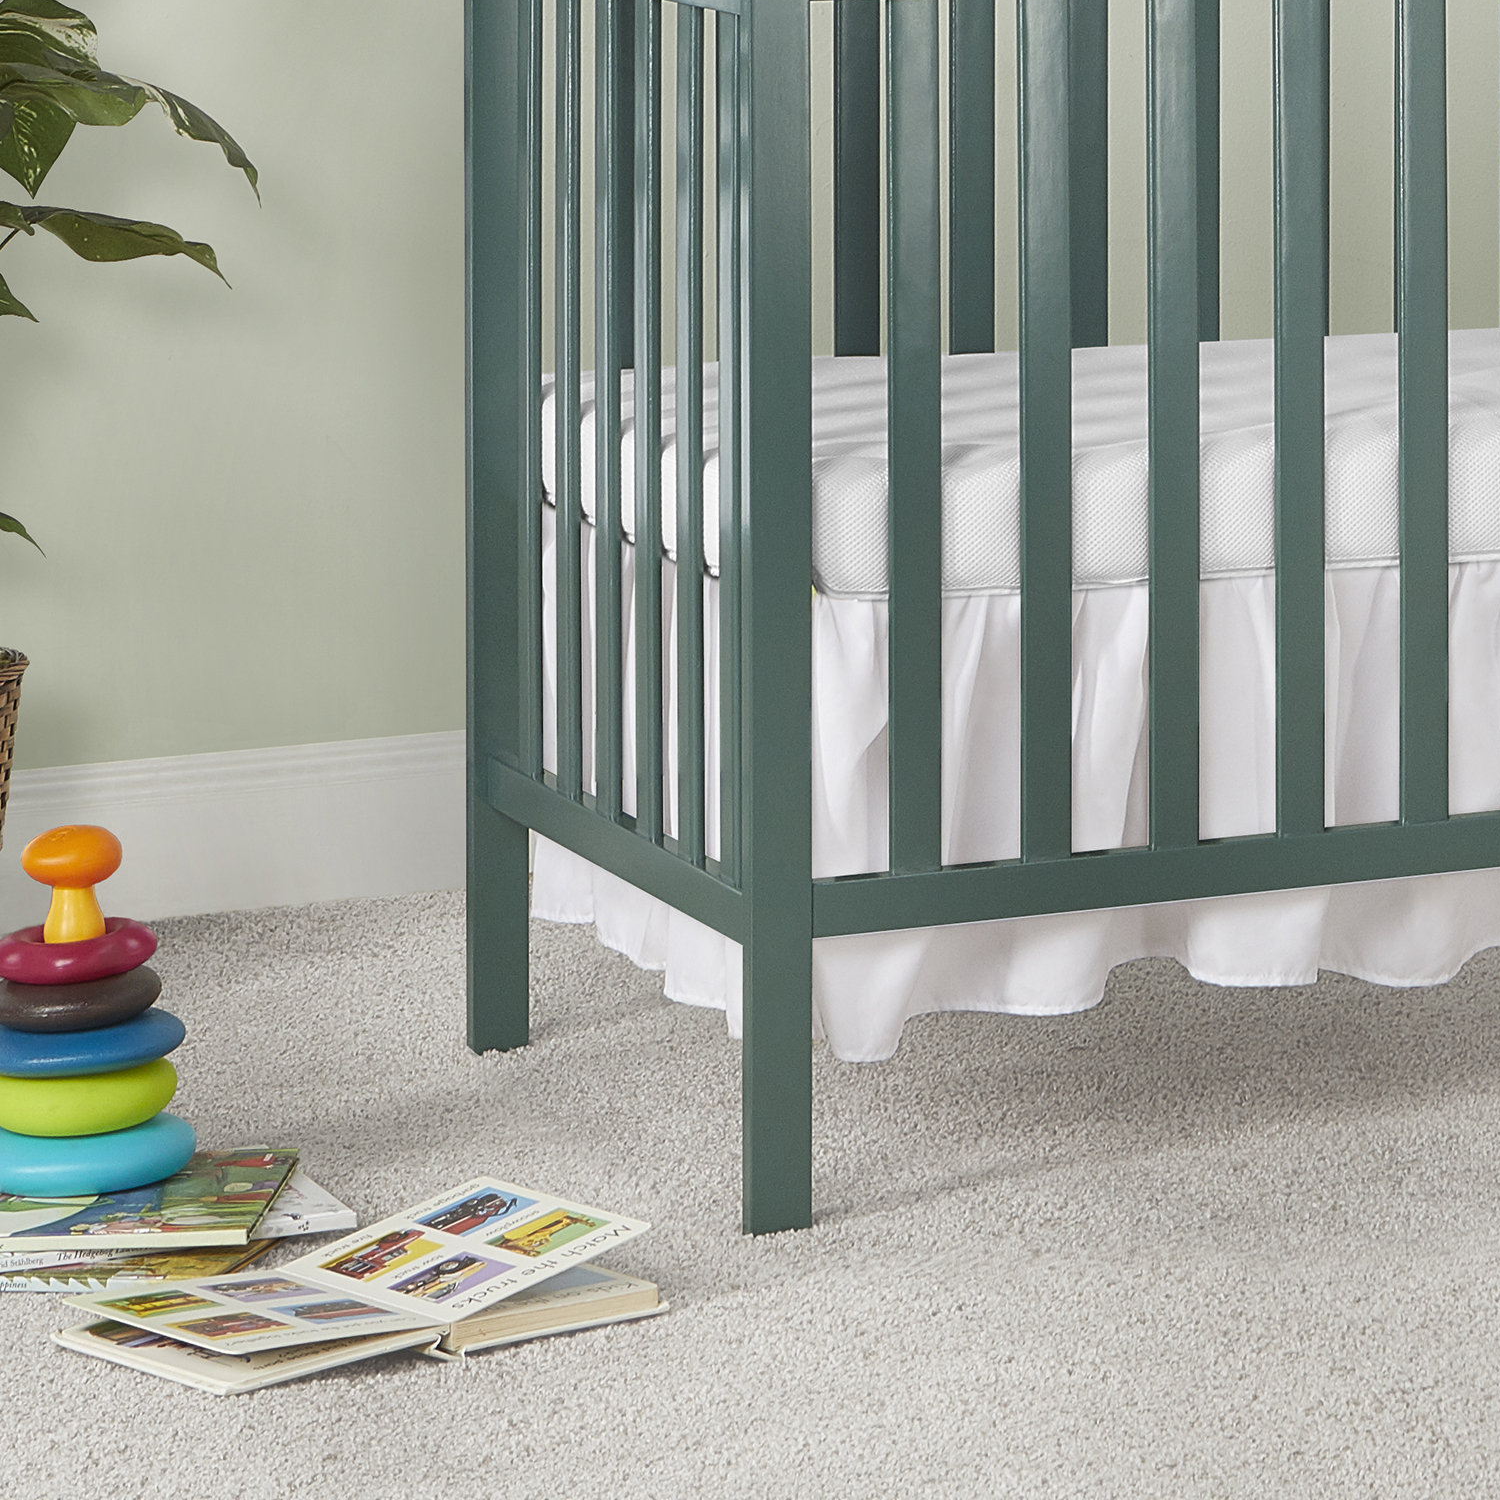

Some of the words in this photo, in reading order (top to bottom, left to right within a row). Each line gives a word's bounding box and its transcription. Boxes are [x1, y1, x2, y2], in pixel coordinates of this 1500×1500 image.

[561, 1224, 633, 1258] Match
[56, 1252, 73, 1261] The
[521, 1259, 559, 1277] the
[451, 1278, 518, 1309] trucks
